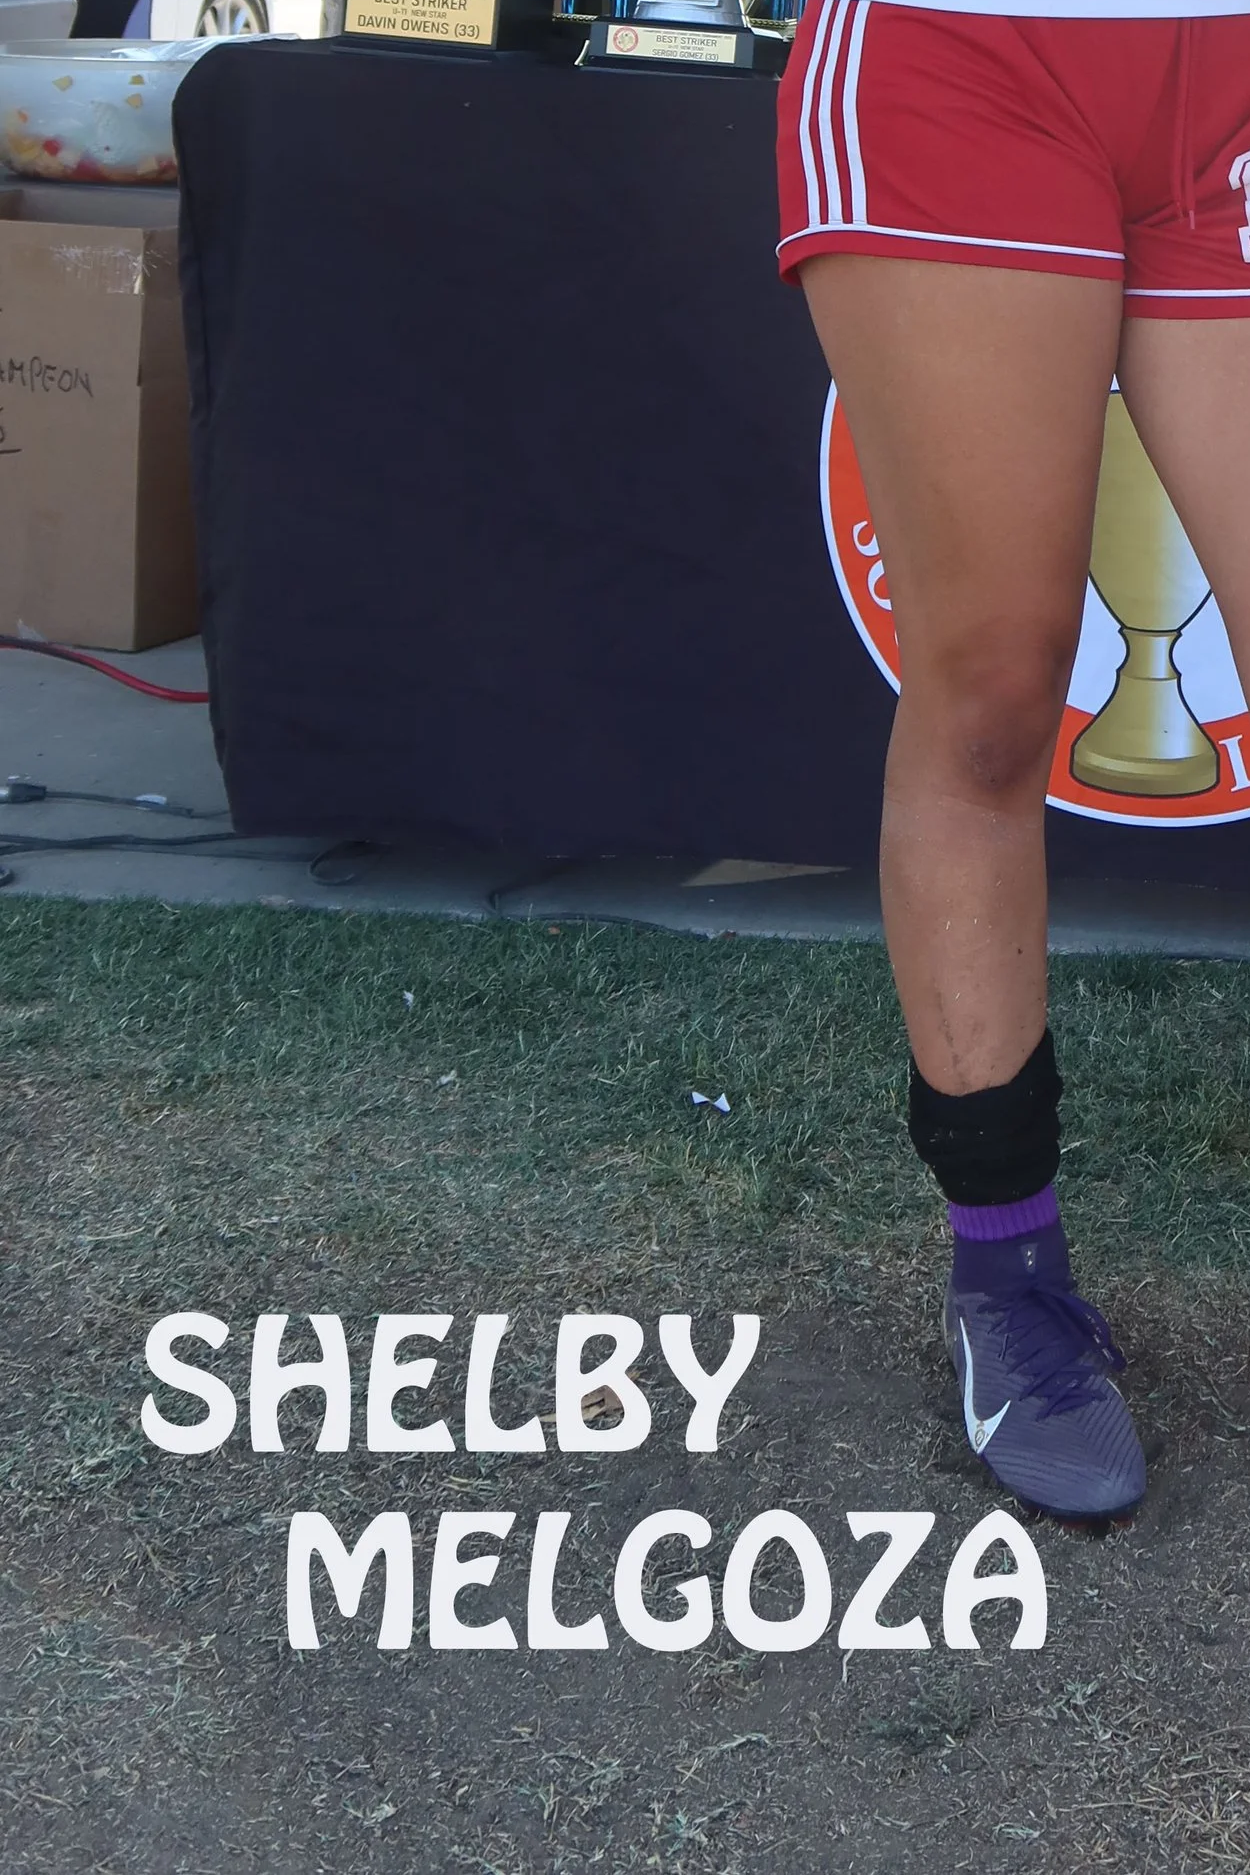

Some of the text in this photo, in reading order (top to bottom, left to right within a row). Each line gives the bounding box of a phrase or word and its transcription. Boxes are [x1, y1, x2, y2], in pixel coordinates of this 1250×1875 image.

[411, 9, 426, 18] NEW
[428, 11, 447, 19] STAR
[357, 14, 480, 40] DAVIN OWENS (33)
[656, 34, 679, 44] BEST
[680, 37, 717, 47] STRIKER
[651, 48, 719, 61] SERGIO GOMEZ (33)
[0, 356, 93, 397] MPEON
